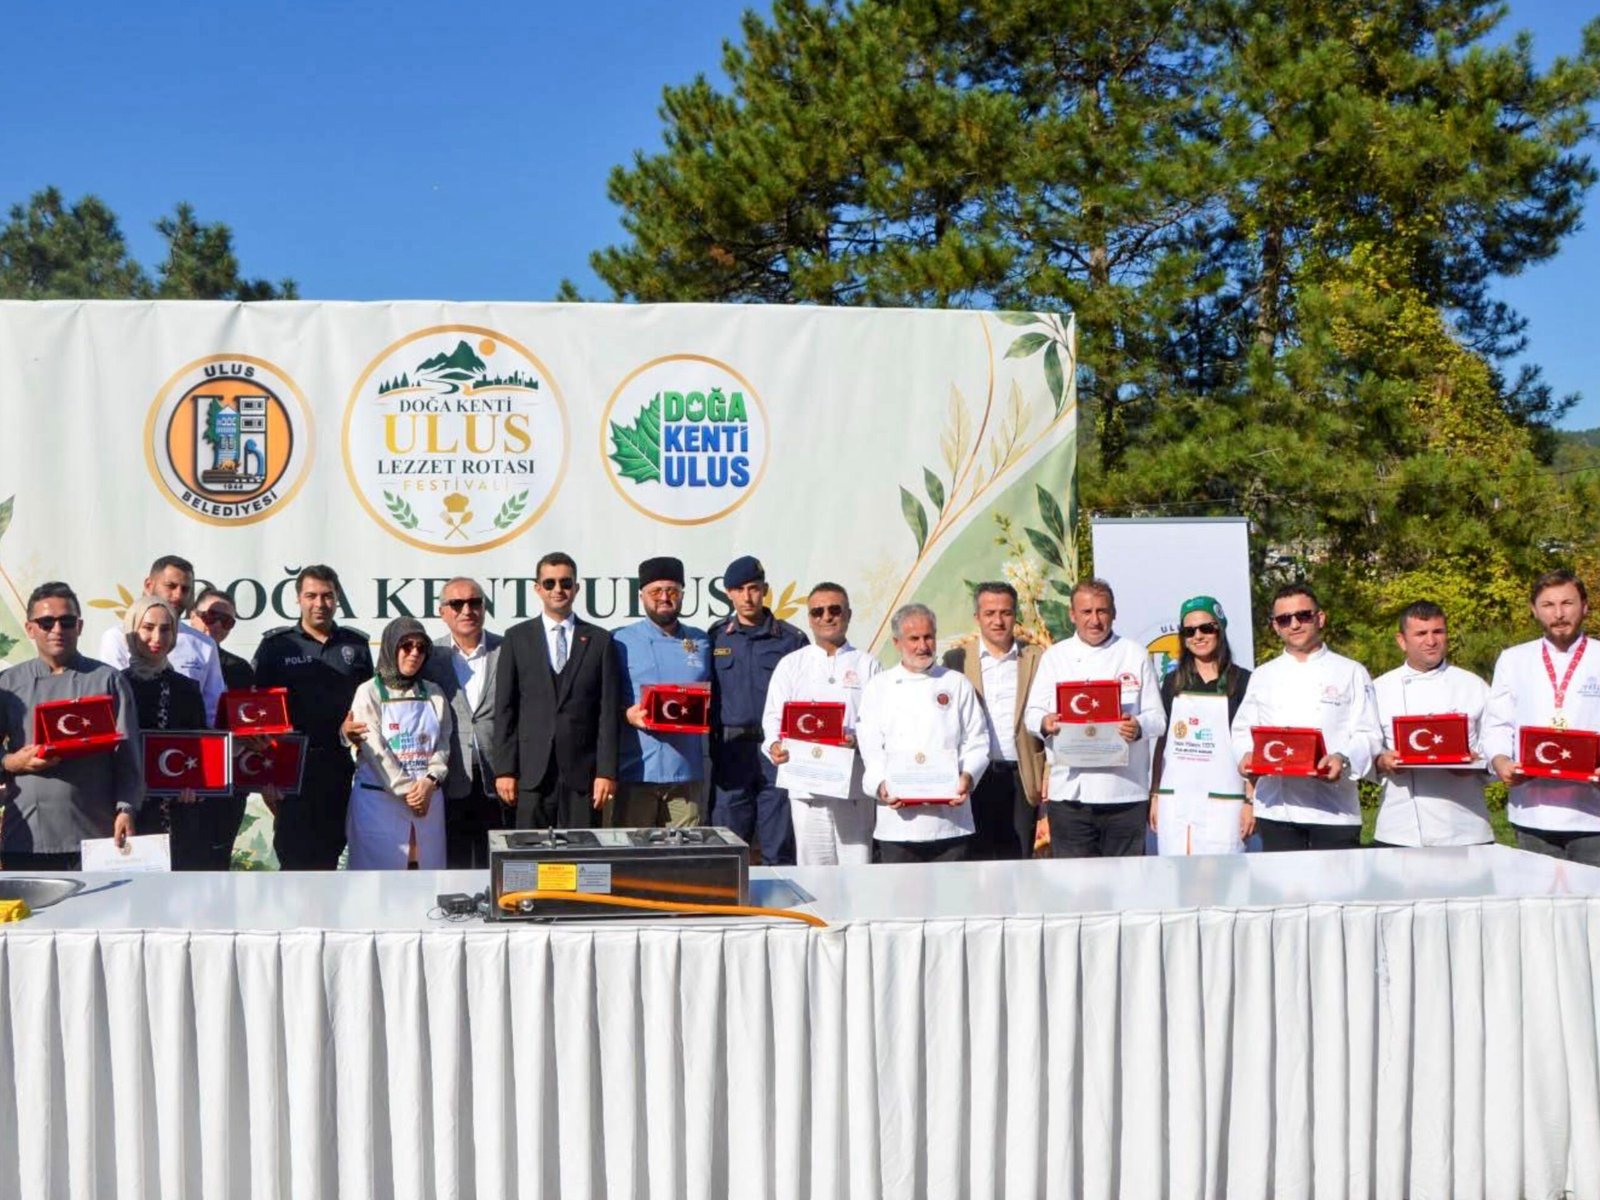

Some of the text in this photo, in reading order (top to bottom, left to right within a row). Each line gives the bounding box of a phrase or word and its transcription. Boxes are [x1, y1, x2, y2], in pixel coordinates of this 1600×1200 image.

[204, 363, 255, 377] ULUS
[400, 396, 511, 413] DOĞA KENTİ
[664, 387, 748, 422] DOĞA
[383, 414, 532, 455] ULUS
[664, 425, 748, 453] KENTİ
[378, 459, 535, 474] LEZZET ROTASI
[664, 456, 750, 488] ULUS
[181, 489, 277, 516] BELEDİYESİ
